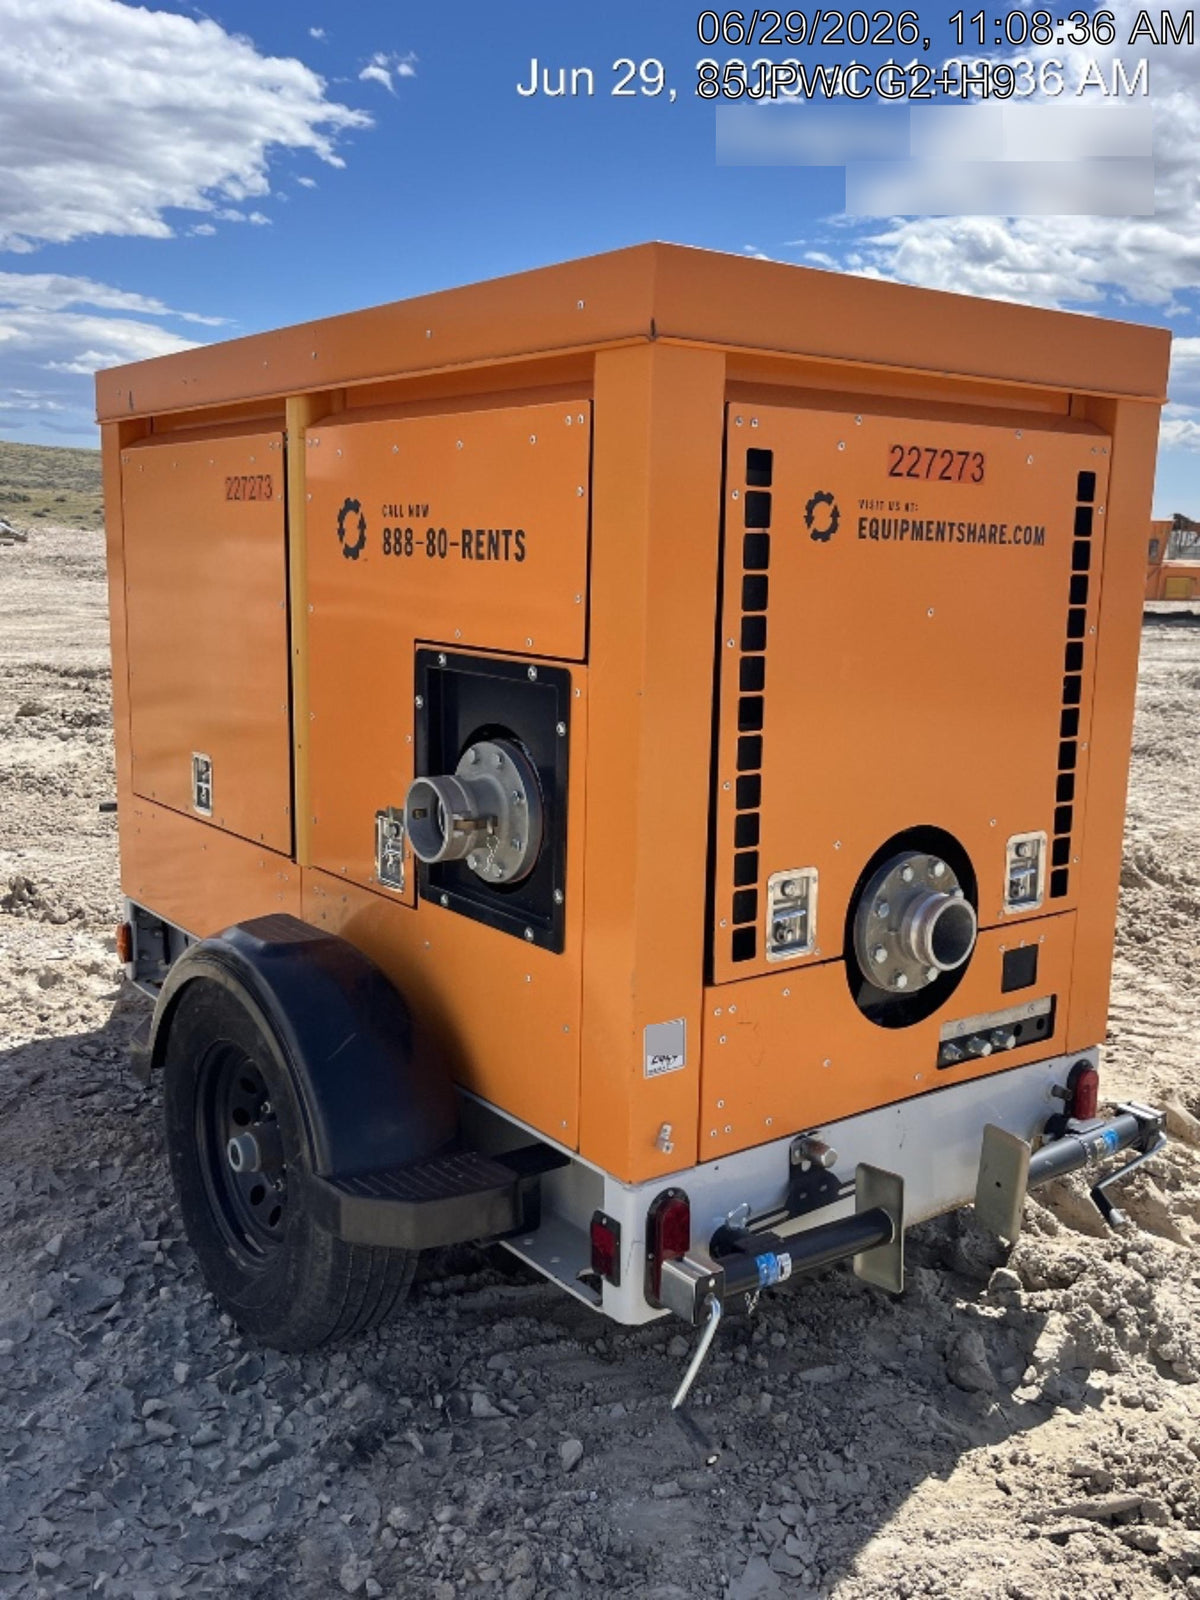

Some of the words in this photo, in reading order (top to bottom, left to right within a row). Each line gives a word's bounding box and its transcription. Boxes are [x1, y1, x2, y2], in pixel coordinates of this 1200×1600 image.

[888, 444, 985, 483] 227273
[225, 474, 272, 500] 227273
[382, 504, 404, 518] CALL
[408, 504, 429, 518] NOW
[858, 499, 885, 511] VISIT
[888, 501, 901, 511] US
[383, 527, 526, 562] 888-80-RENTS
[857, 516, 1046, 546] EQUIPMENTSHARE.COM
